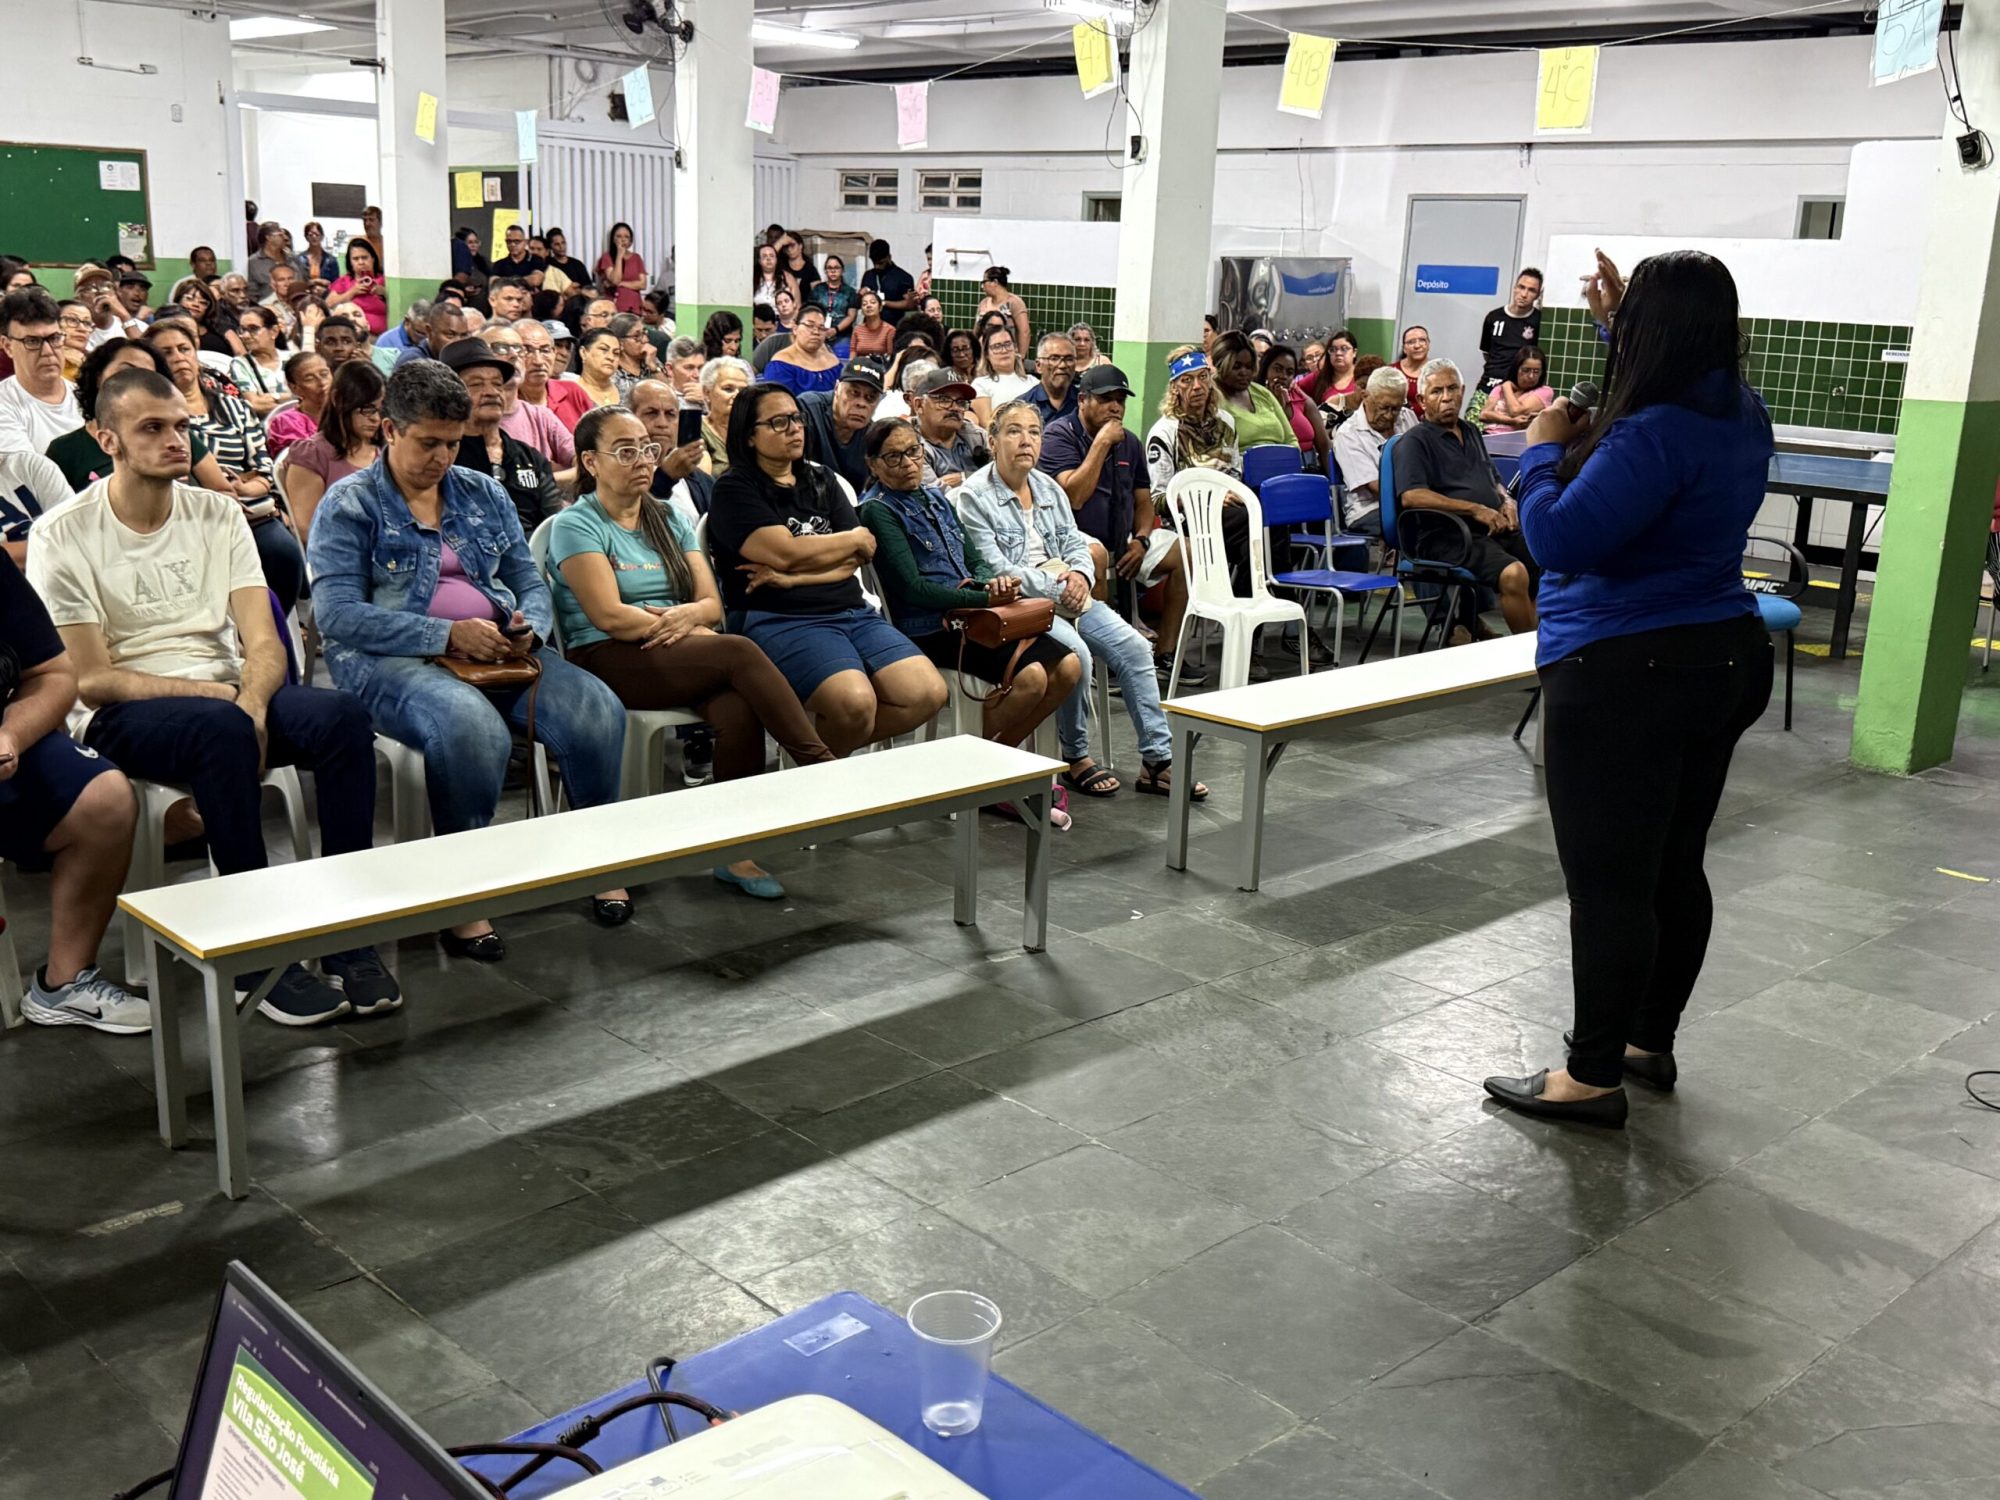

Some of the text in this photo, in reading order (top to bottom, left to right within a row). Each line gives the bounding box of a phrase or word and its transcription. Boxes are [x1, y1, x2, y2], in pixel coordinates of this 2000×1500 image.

[1417, 279, 1449, 290] Depósito
[1493, 320, 1505, 337] 11
[232, 1393, 254, 1430] Vila
[254, 1417, 277, 1453] São
[276, 1443, 306, 1483] José
[296, 1433, 340, 1489] Fundiária
